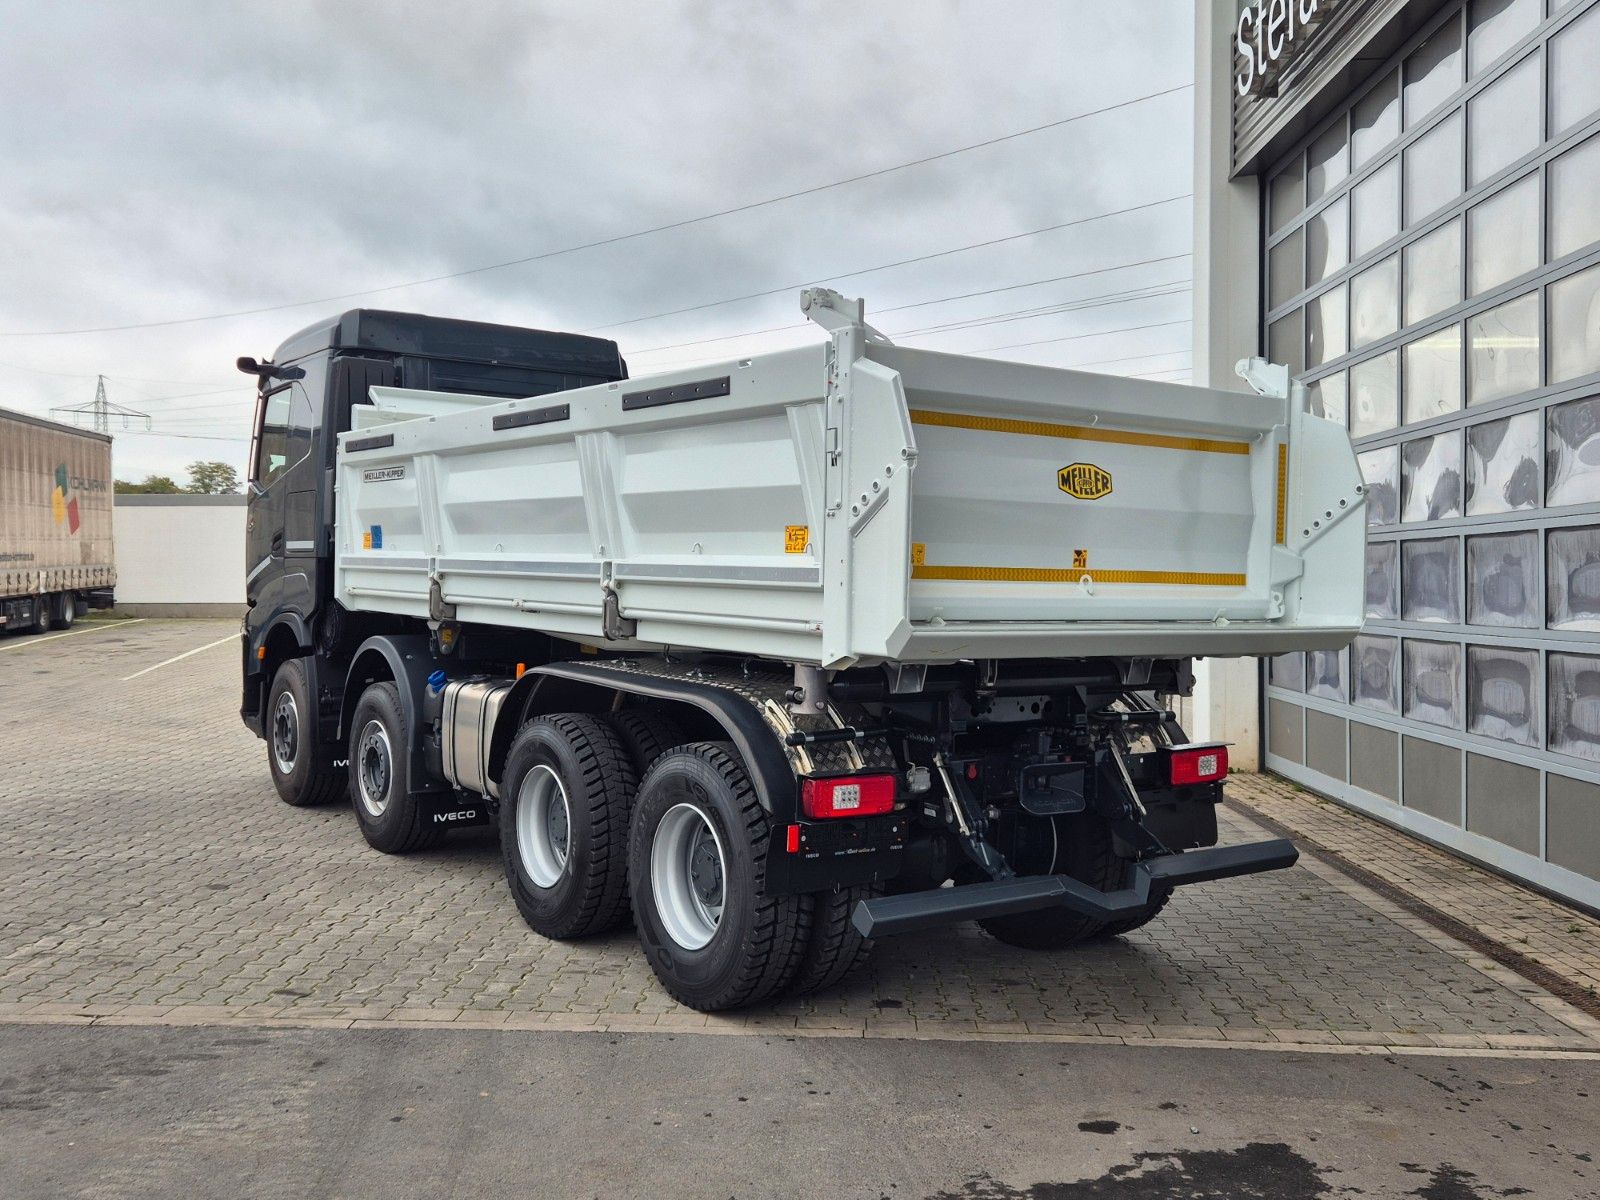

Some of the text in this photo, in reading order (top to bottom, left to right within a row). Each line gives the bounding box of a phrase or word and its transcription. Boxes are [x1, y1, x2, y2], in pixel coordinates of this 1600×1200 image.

[364, 469, 404, 480] MEILLER-KIPPER
[1060, 466, 1110, 496] MEILLER
[433, 810, 476, 823] IVECO
